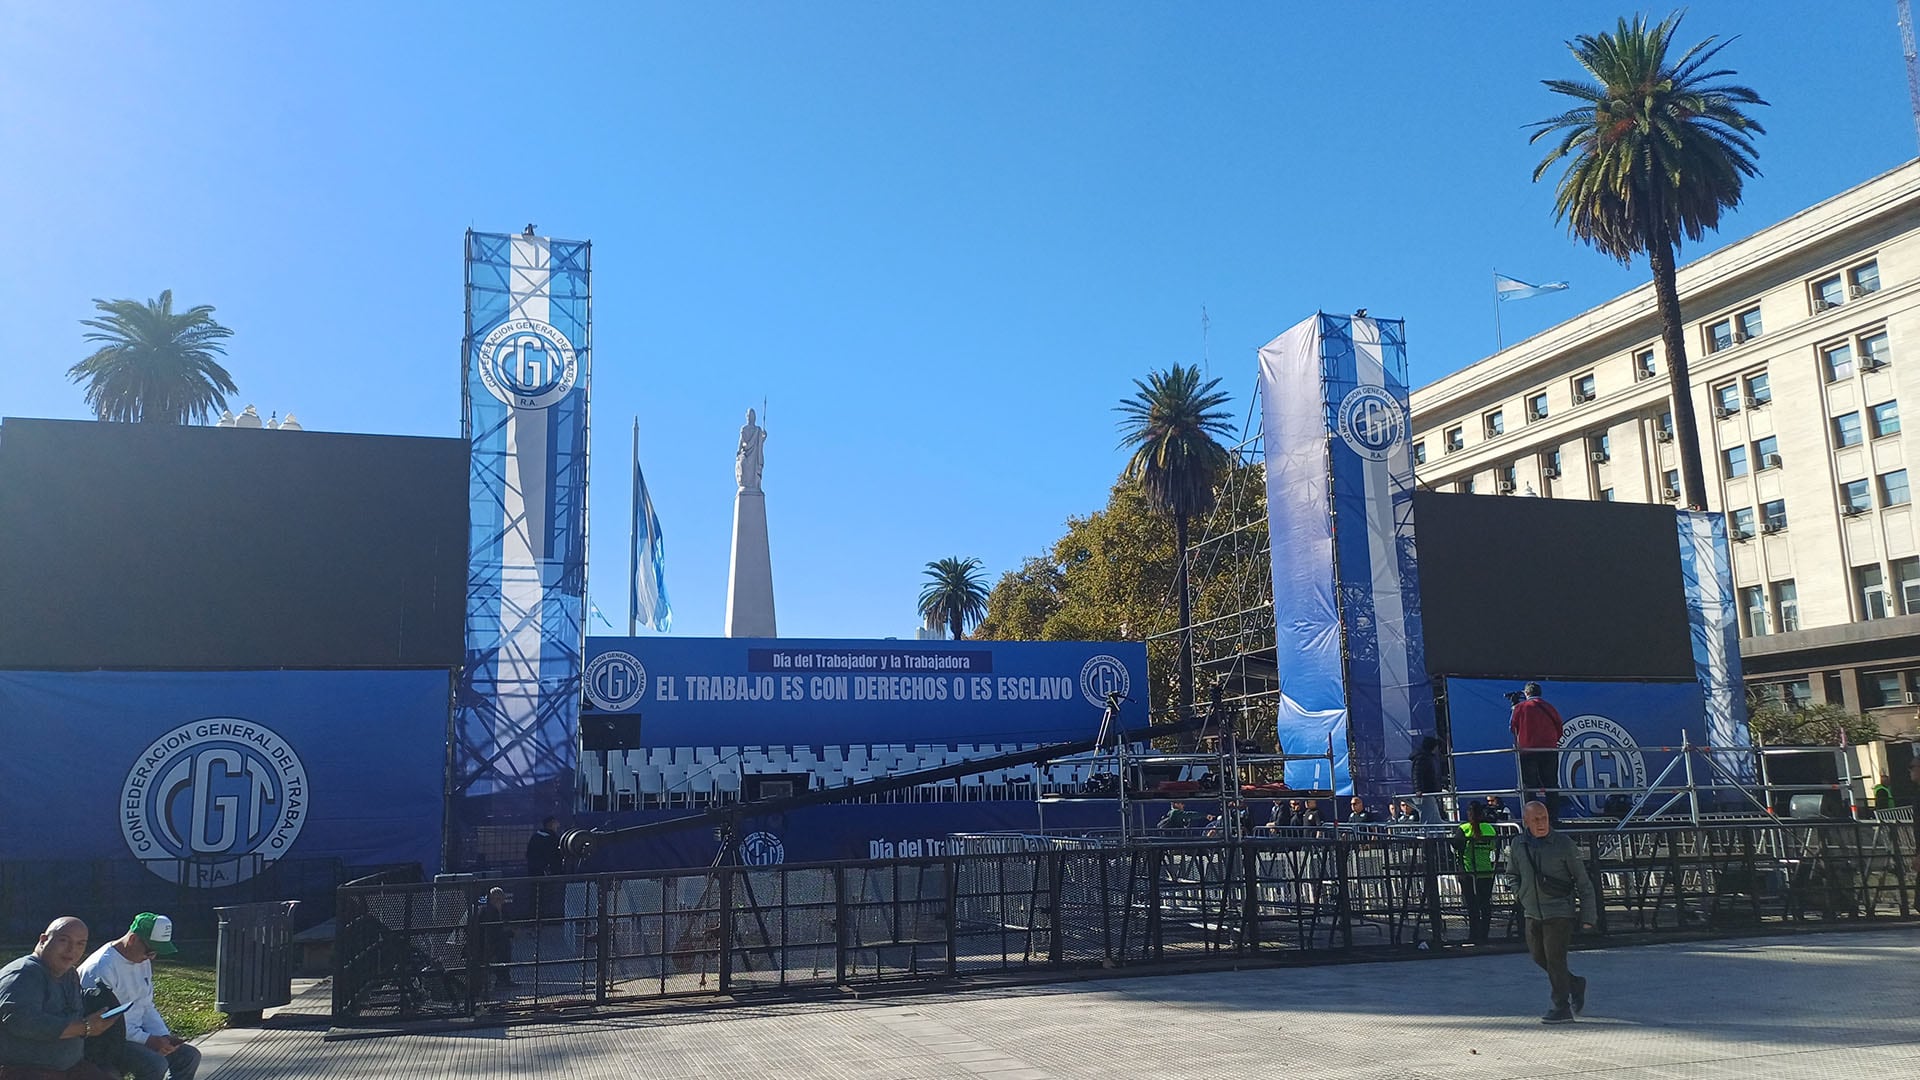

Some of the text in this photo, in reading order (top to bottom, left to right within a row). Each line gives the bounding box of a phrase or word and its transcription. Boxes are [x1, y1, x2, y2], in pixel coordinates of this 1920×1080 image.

[516, 322, 558, 341] GENERAL
[556, 338, 570, 353] DEL
[497, 336, 560, 391] CGT
[773, 654, 971, 670] Día del Trabajador y la Trabajadora
[596, 663, 635, 699] CGT
[656, 676, 1072, 700] EL TRABAJO ES CON DERECHOS O ES ESCLAVO
[1577, 719, 1622, 741] GENERAL
[127, 723, 302, 852] CONFEDERACION GENERAL DEL TRABAJO
[156, 748, 275, 853] CGT
[869, 838, 894, 859] Día
[898, 839, 922, 858] del
